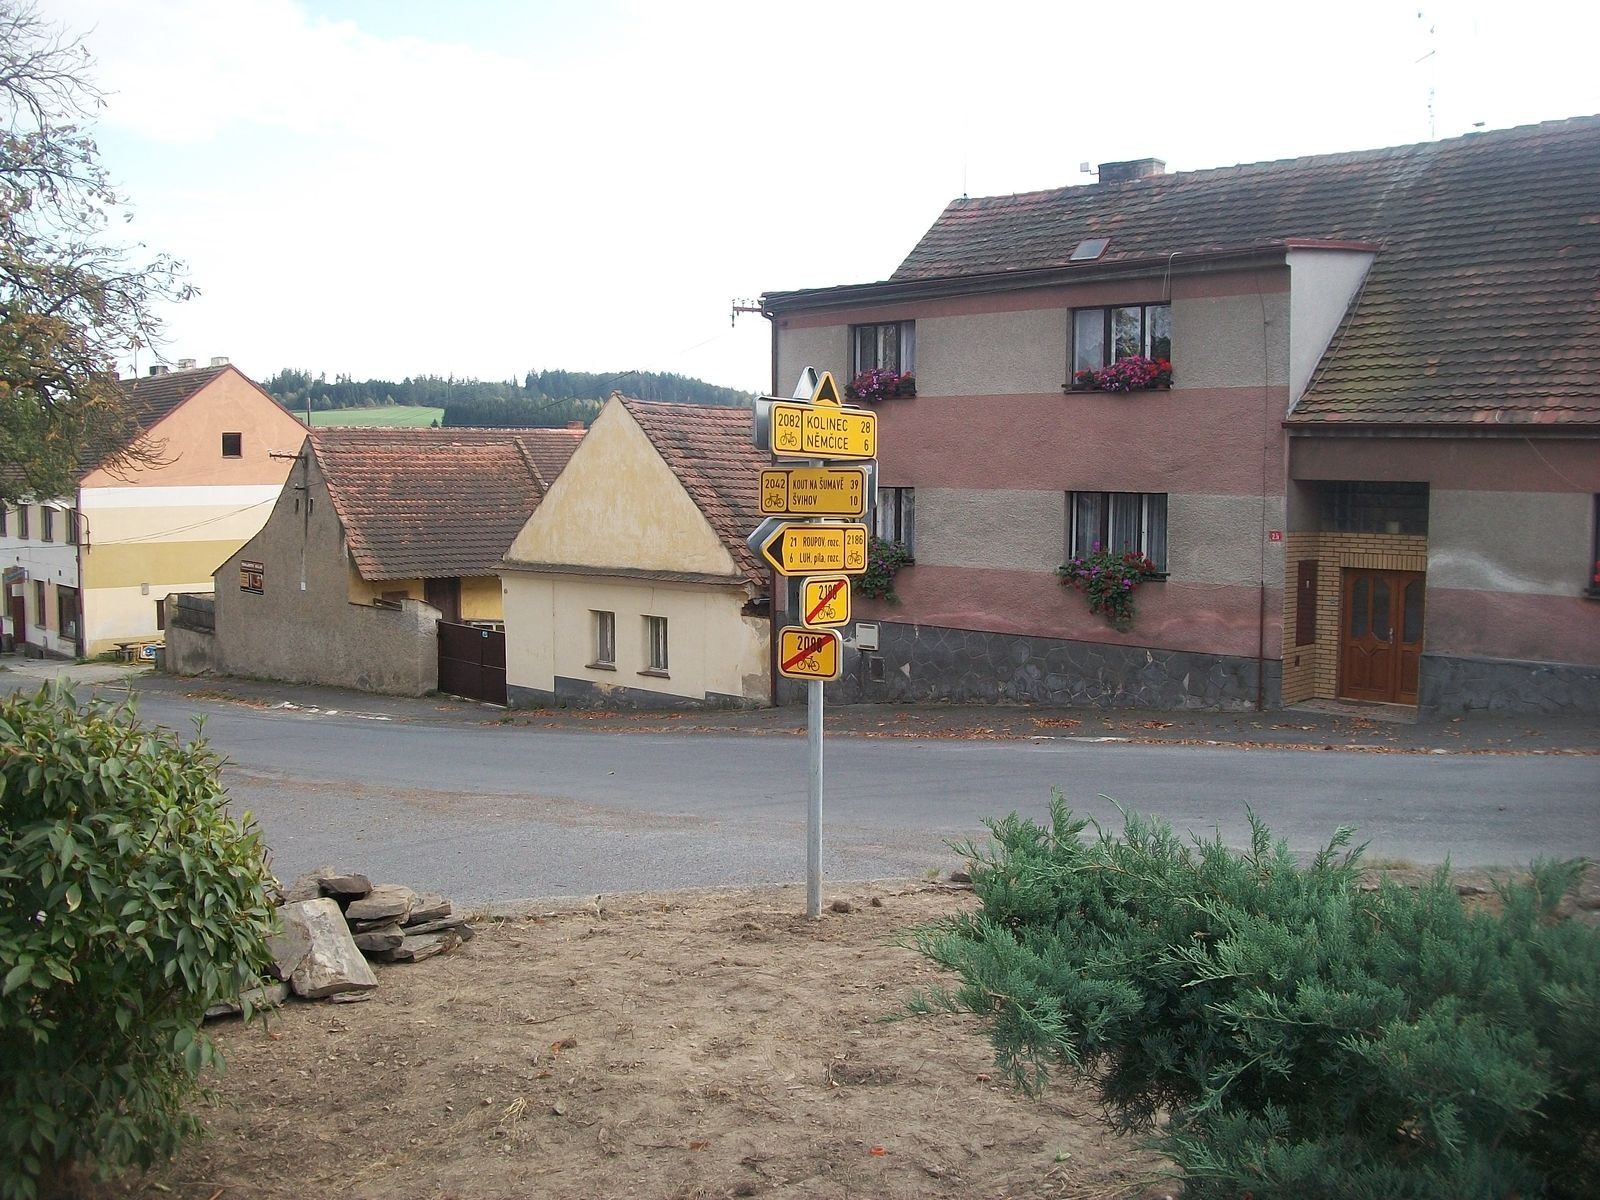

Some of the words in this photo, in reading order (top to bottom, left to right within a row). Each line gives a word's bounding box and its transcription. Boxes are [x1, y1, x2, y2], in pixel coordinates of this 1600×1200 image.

[778, 413, 800, 428] 2082
[806, 415, 848, 431] KOLINEC
[860, 421, 871, 434] 28
[806, 432, 849, 450] NĚMČICE
[863, 439, 869, 452] 6
[765, 478, 785, 489] 2042
[792, 479, 808, 490] KOUT
[809, 480, 818, 490] NA
[819, 476, 844, 490] ŠUMAVĚ
[850, 479, 859, 490] 39
[792, 492, 818, 506] ŠVIHOV
[850, 496, 858, 506] 10
[790, 536, 797, 547] 21
[847, 535, 864, 545] 2186
[789, 553, 794, 563] 6
